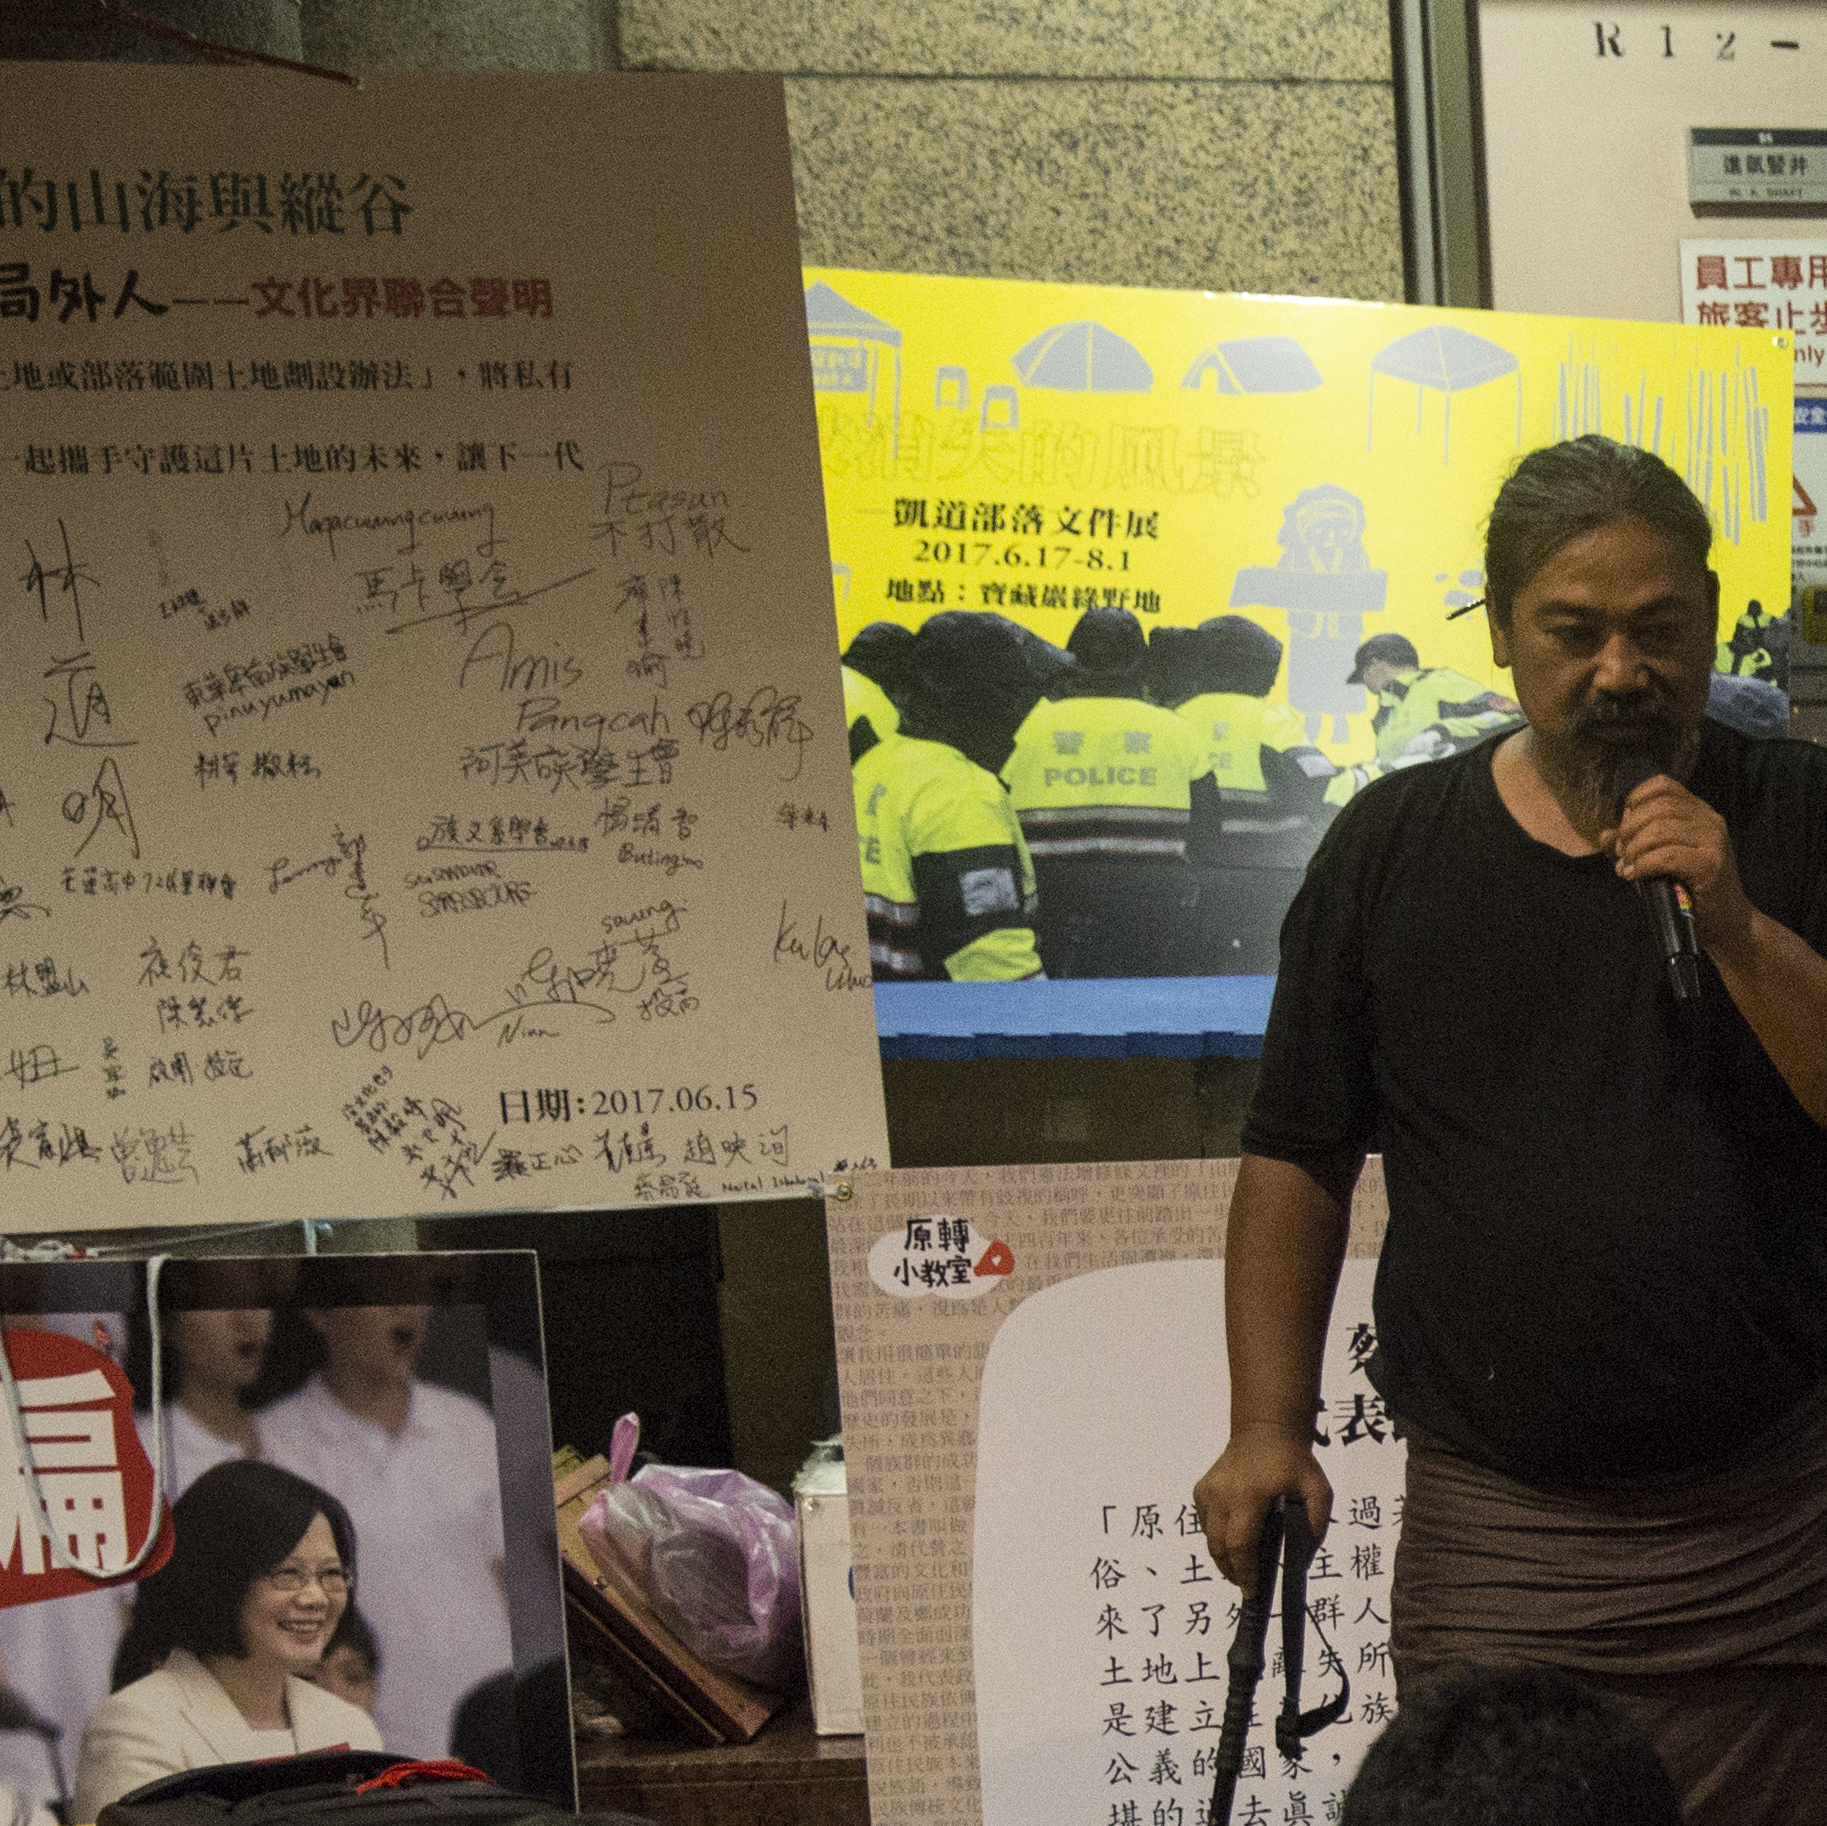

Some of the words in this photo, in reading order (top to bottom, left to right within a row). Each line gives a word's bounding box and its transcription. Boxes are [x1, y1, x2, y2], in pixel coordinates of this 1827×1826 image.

[1794, 344, 1826, 368] nly
[912, 539, 1132, 572] 2017.6.17-8.1
[459, 620, 584, 693] Amis
[1043, 765, 1157, 787] POLICE
[904, 1217, 972, 1254] 原轉
[892, 1254, 973, 1289] 小教室
